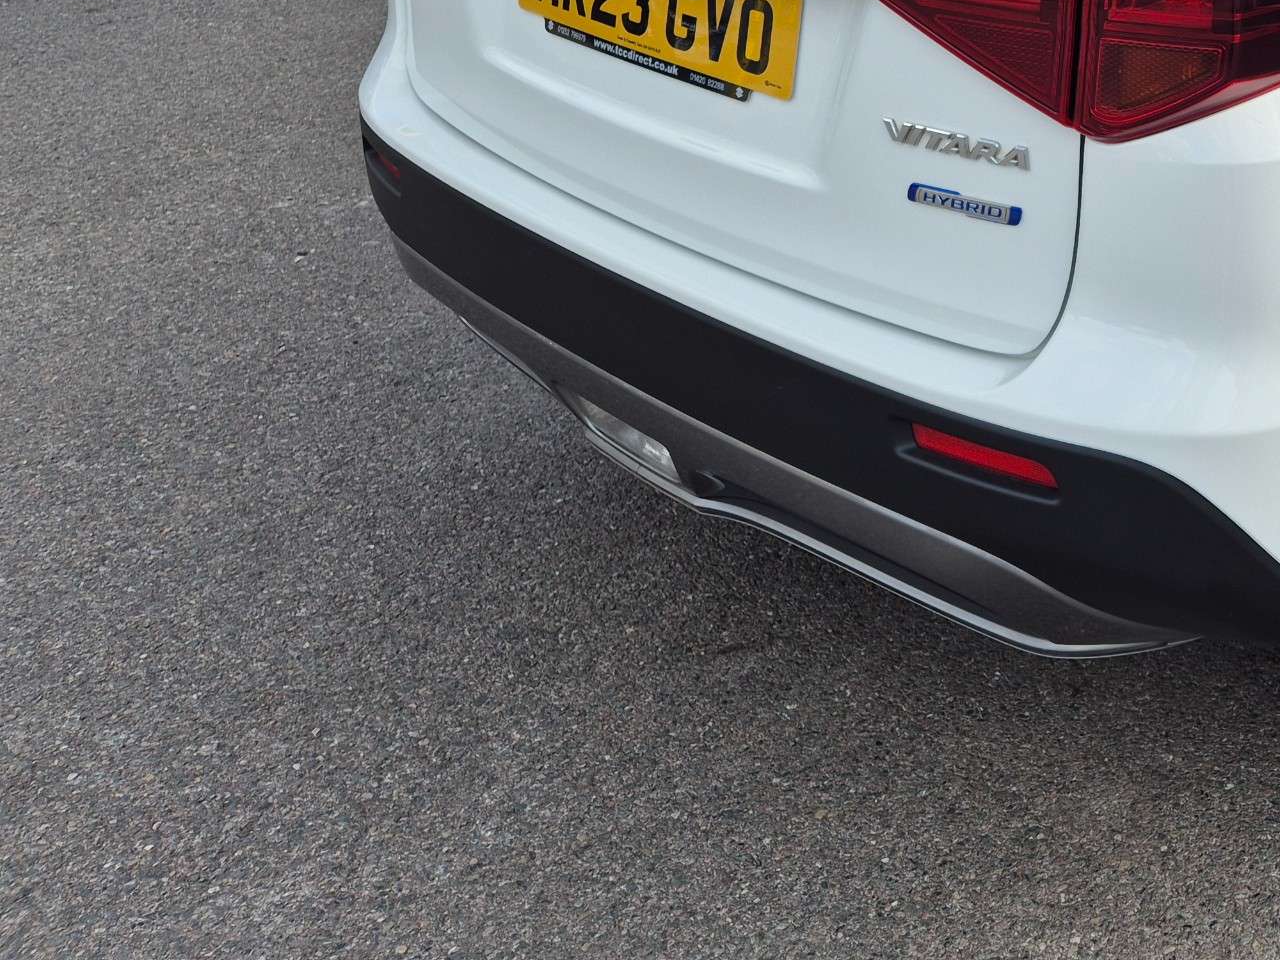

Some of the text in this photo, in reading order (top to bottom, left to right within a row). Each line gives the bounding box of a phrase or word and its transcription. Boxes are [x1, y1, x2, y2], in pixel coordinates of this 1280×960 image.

[593, 38, 679, 76] www.tccdirect.co.uk
[882, 117, 1031, 172] VITARA
[923, 191, 1002, 218] HYBRID
